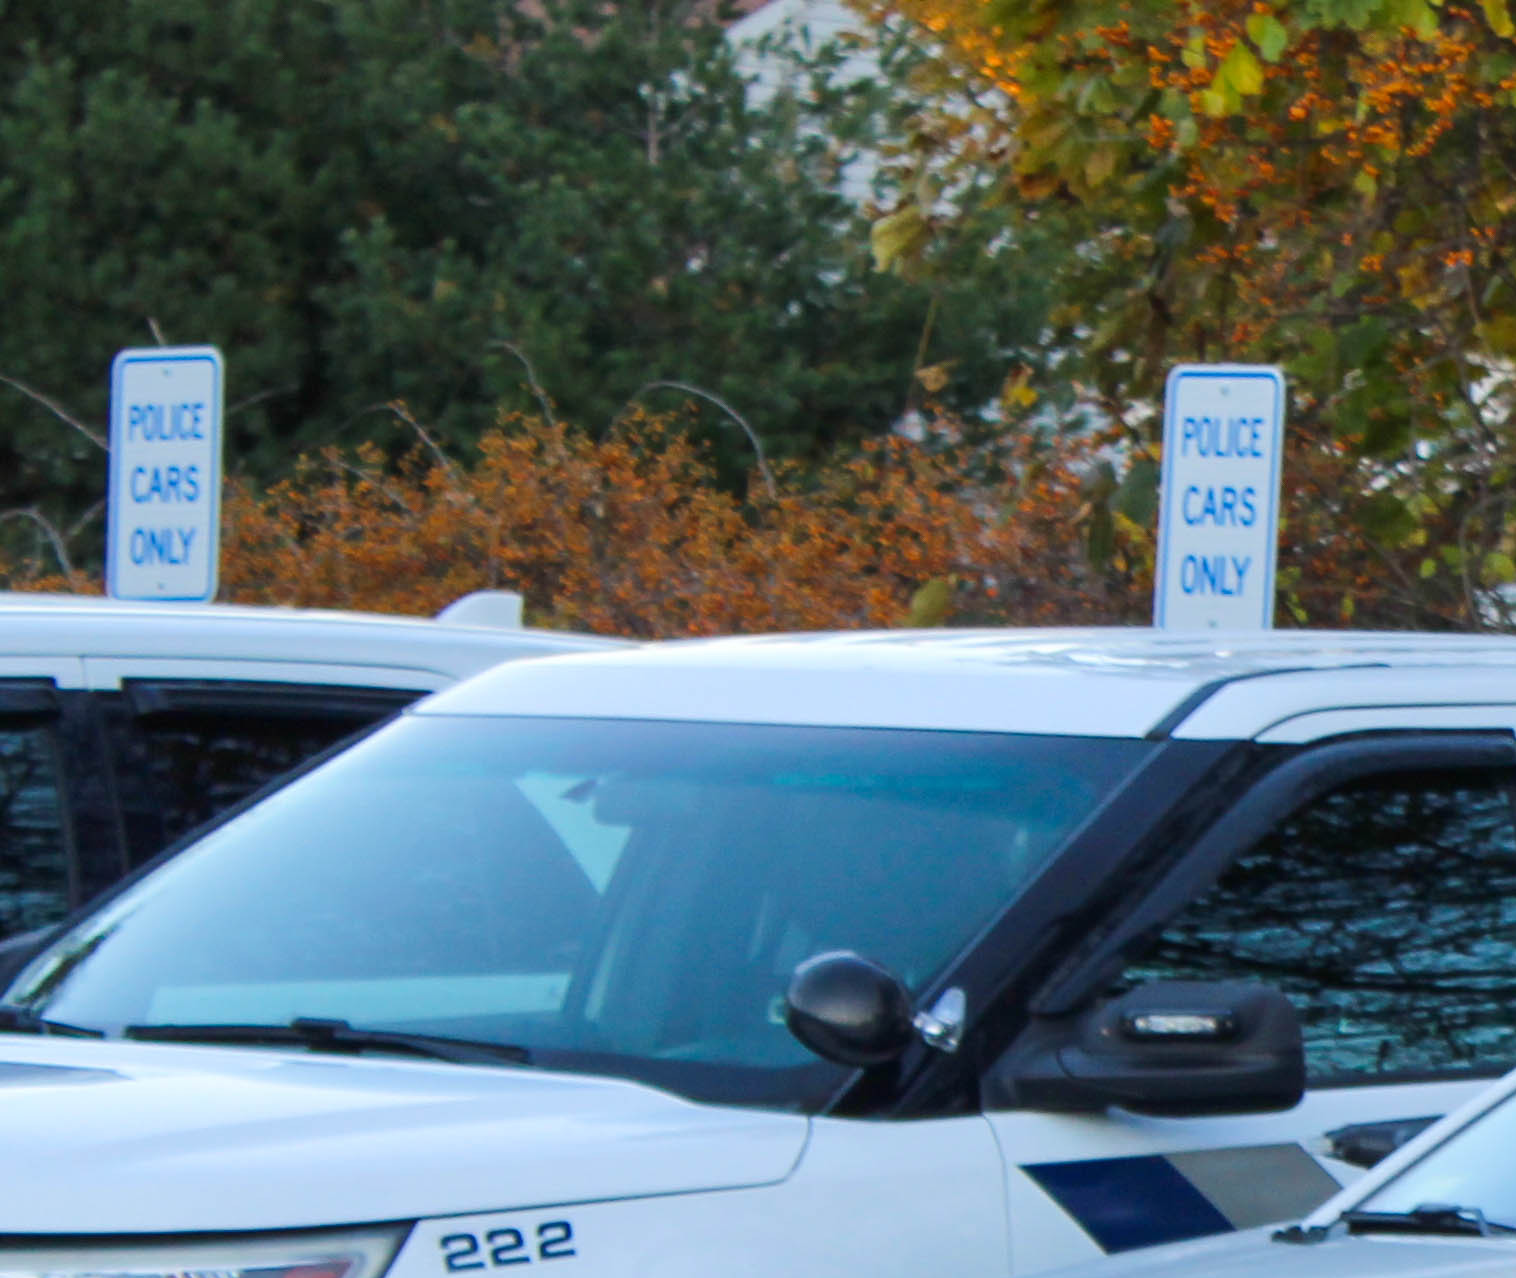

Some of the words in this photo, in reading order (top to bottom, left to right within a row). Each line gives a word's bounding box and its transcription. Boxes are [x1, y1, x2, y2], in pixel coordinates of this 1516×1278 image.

[128, 403, 205, 441] POLICE
[1181, 416, 1265, 458] POLICE
[131, 466, 200, 503] CARS
[1182, 485, 1258, 527] CARS
[130, 527, 197, 565] ONLY
[1180, 554, 1252, 596] ONLY
[440, 1220, 577, 1275] 222
